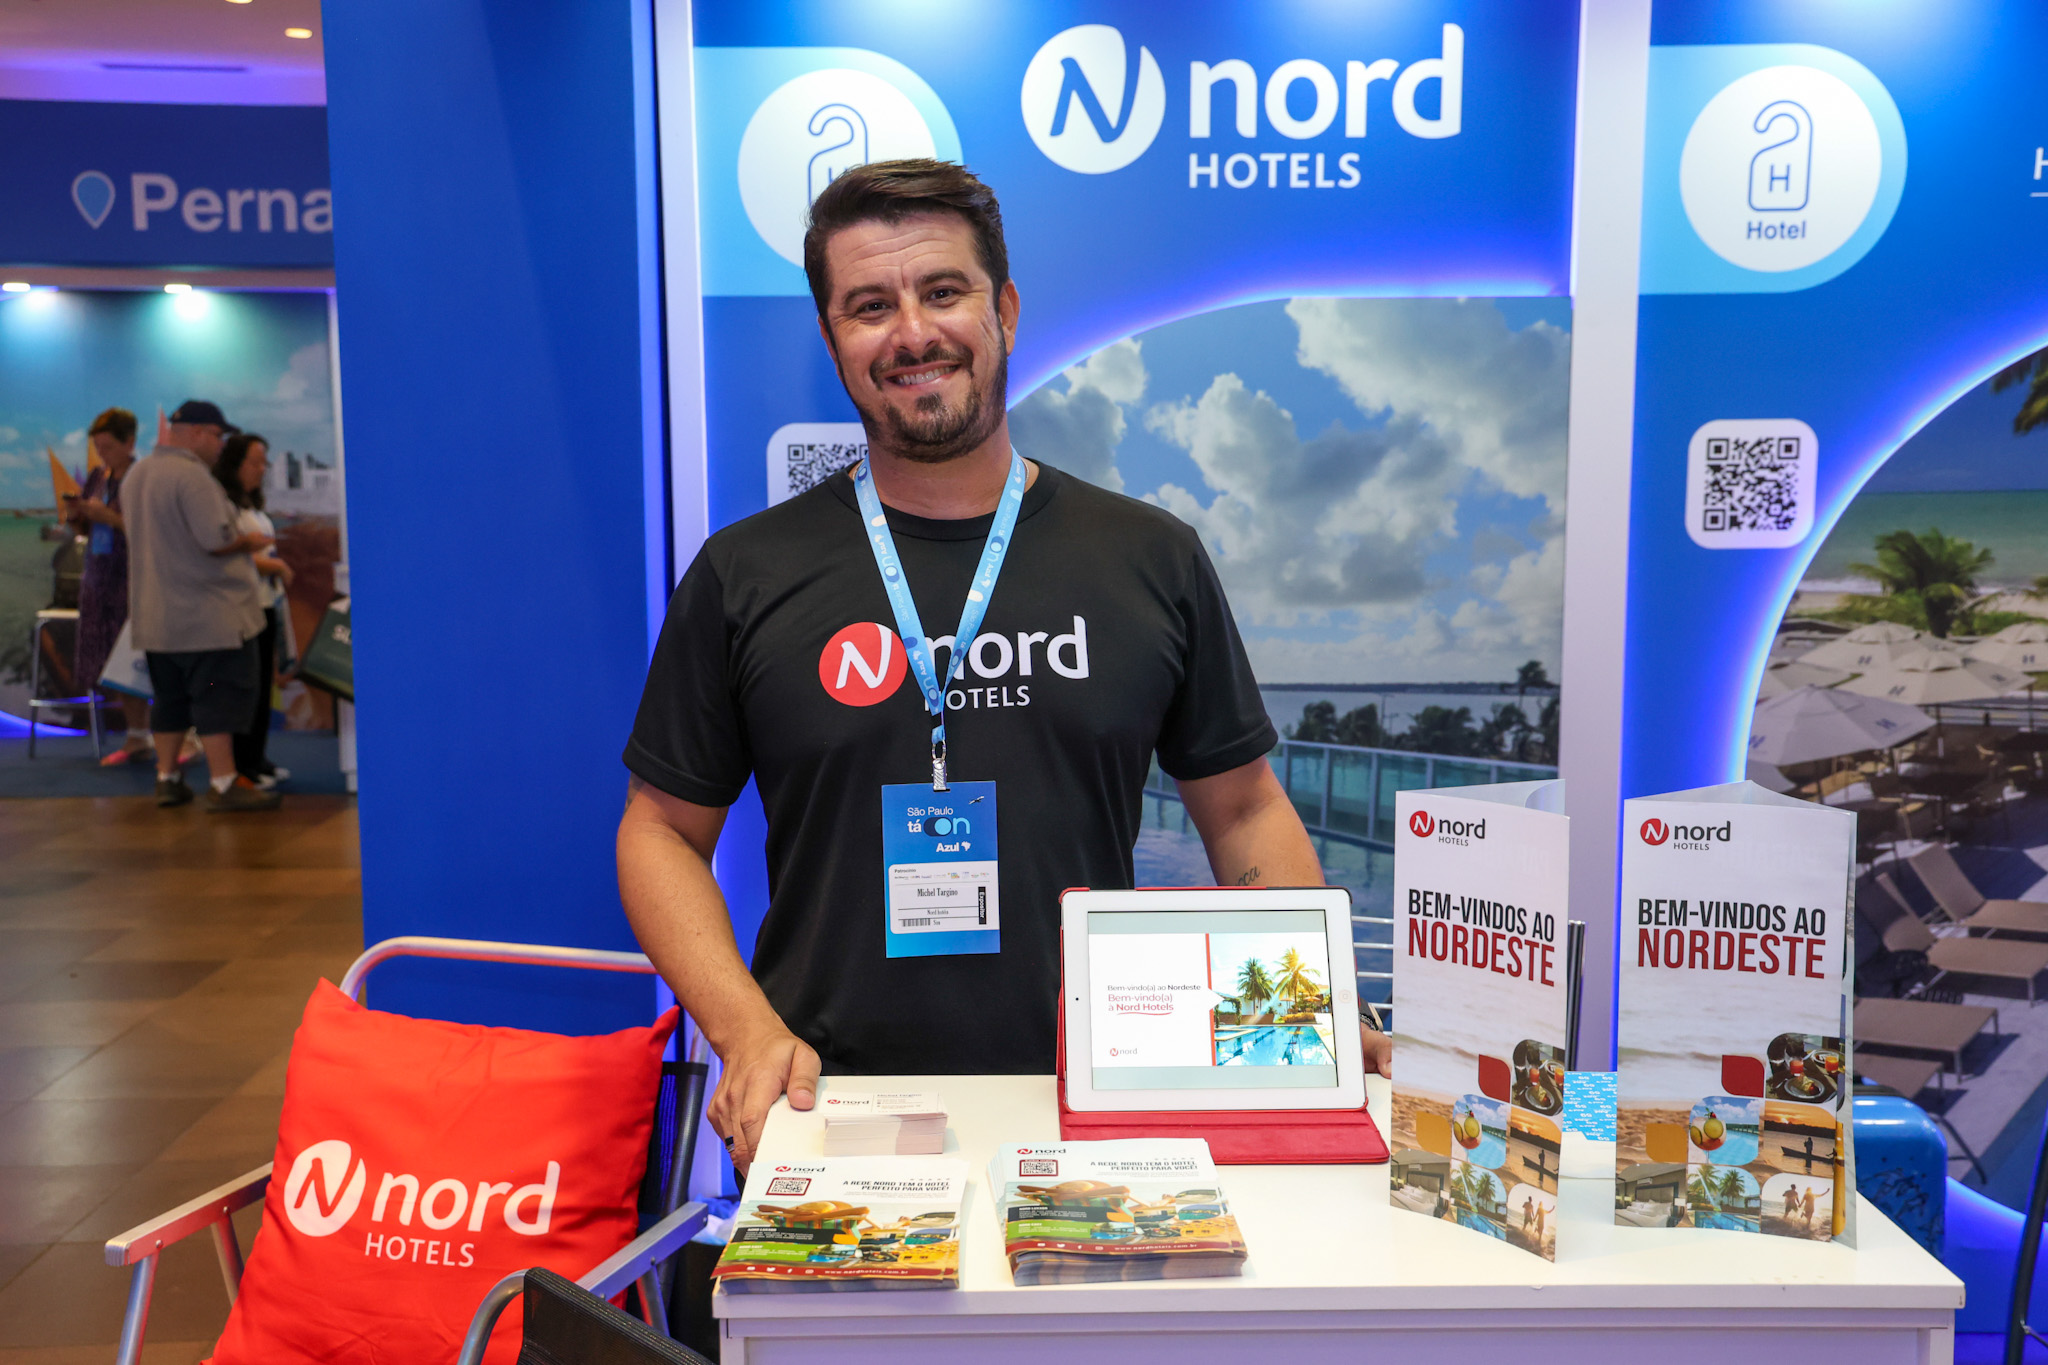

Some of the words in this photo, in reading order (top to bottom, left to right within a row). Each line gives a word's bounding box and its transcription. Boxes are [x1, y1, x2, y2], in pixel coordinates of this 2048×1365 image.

[1190, 23, 1465, 139] nord
[1189, 153, 1361, 188] HOTELS
[1747, 220, 1806, 239] Hotel
[925, 615, 1090, 680] nord
[907, 807, 926, 817] São
[927, 806, 954, 816] Paulo
[907, 819, 922, 833] tá
[1438, 818, 1486, 840] nord
[1674, 820, 1731, 842] nord
[936, 842, 960, 853] Azul
[1438, 836, 1469, 847] HOTELS
[1673, 842, 1710, 851] HOTELS
[917, 888, 936, 898] Michel
[937, 887, 959, 898] Targino
[1408, 888, 1528, 936] BEM-VINDOS
[1532, 911, 1555, 943] AO
[1638, 898, 1787, 933] BEM-VINDOS
[1793, 907, 1826, 936] AO
[1408, 917, 1555, 987] NORDESTE
[1637, 928, 1826, 979] NORDESTE
[1108, 993, 1173, 1003] Bem-vindo(a)
[1116, 1003, 1141, 1011] Nord
[1143, 1002, 1174, 1011] Hotels
[371, 1160, 561, 1236] nord
[364, 1232, 475, 1268] HOTELS
